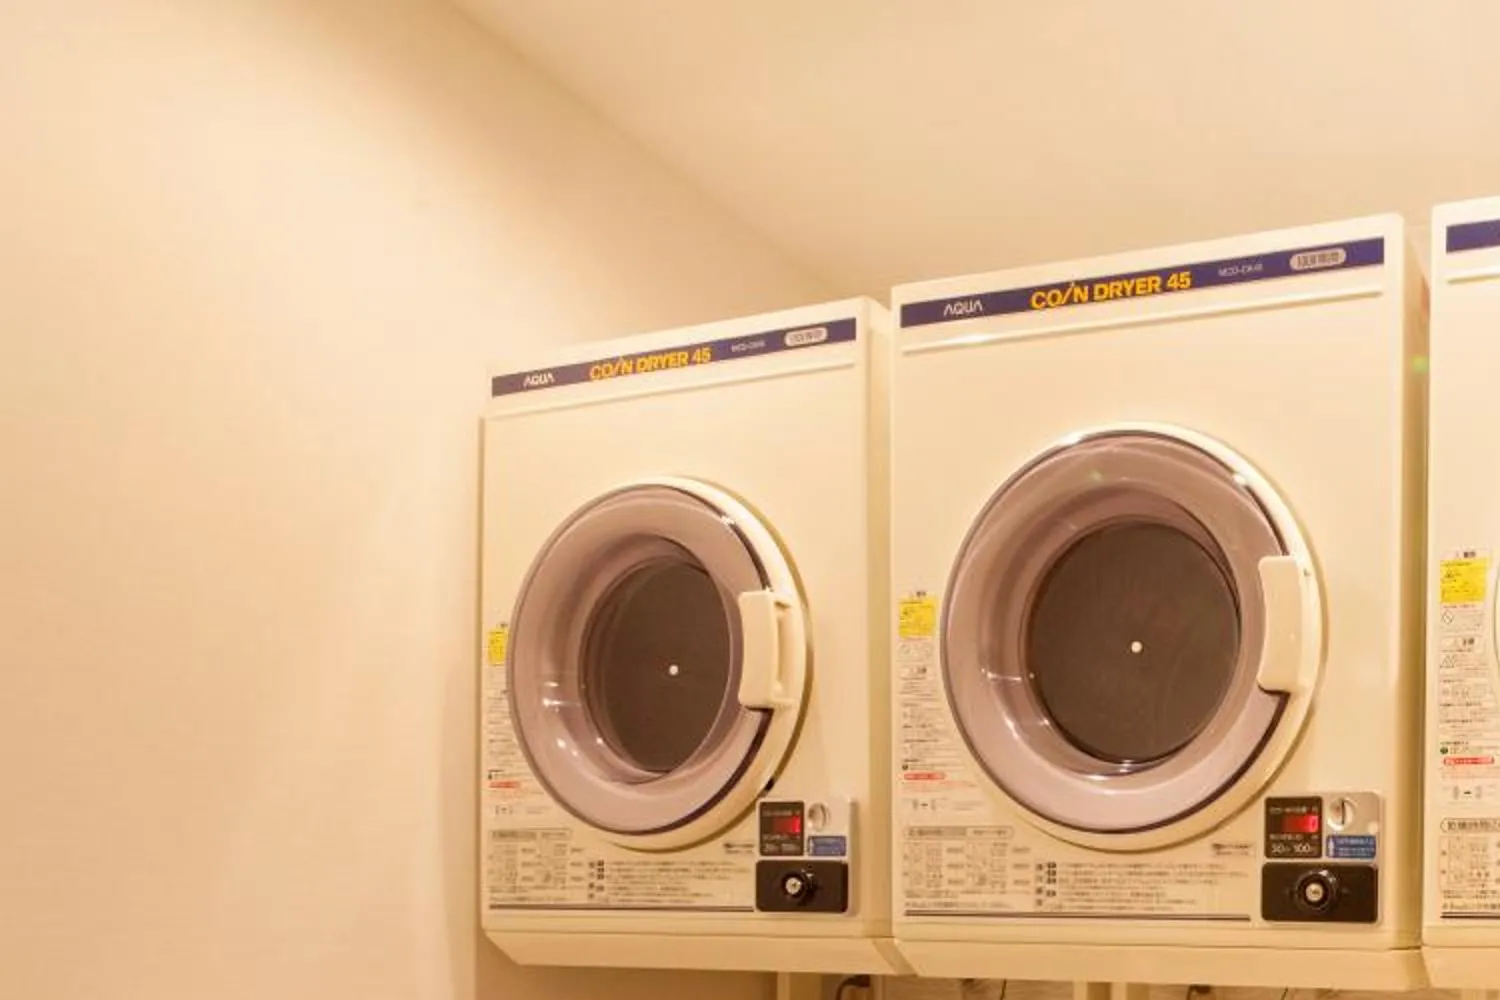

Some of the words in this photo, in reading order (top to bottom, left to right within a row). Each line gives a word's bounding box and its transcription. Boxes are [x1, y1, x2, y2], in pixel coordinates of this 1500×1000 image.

[943, 300, 983, 317] AQUA
[1093, 276, 1161, 302] DRYER
[1167, 271, 1191, 290] 45
[524, 373, 556, 388] AQUA
[636, 349, 688, 374] DRYER
[693, 346, 712, 364] 45
